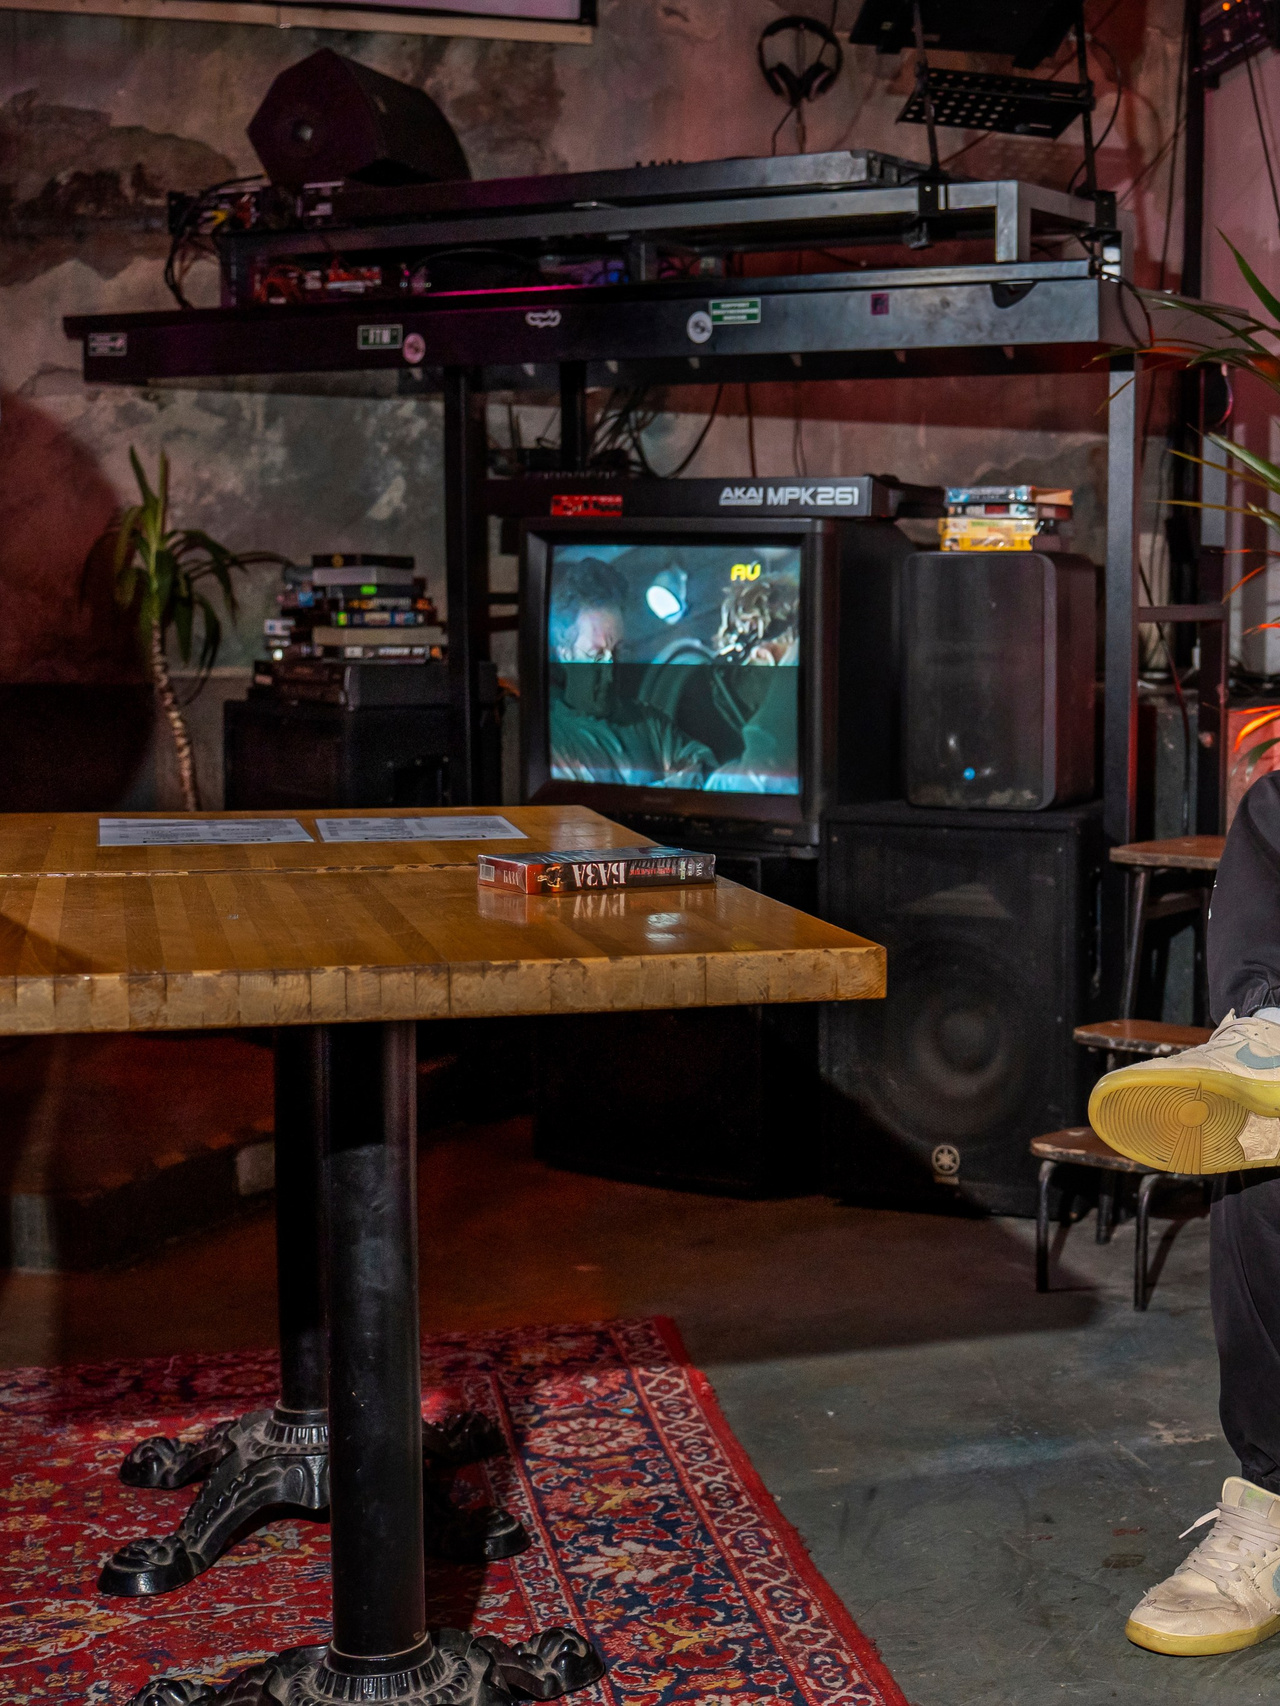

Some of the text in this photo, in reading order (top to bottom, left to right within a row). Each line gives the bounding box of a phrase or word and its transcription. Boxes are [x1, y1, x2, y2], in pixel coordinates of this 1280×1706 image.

[719, 486, 859, 506] AKAI MPK261
[571, 861, 627, 888] БАЗА
